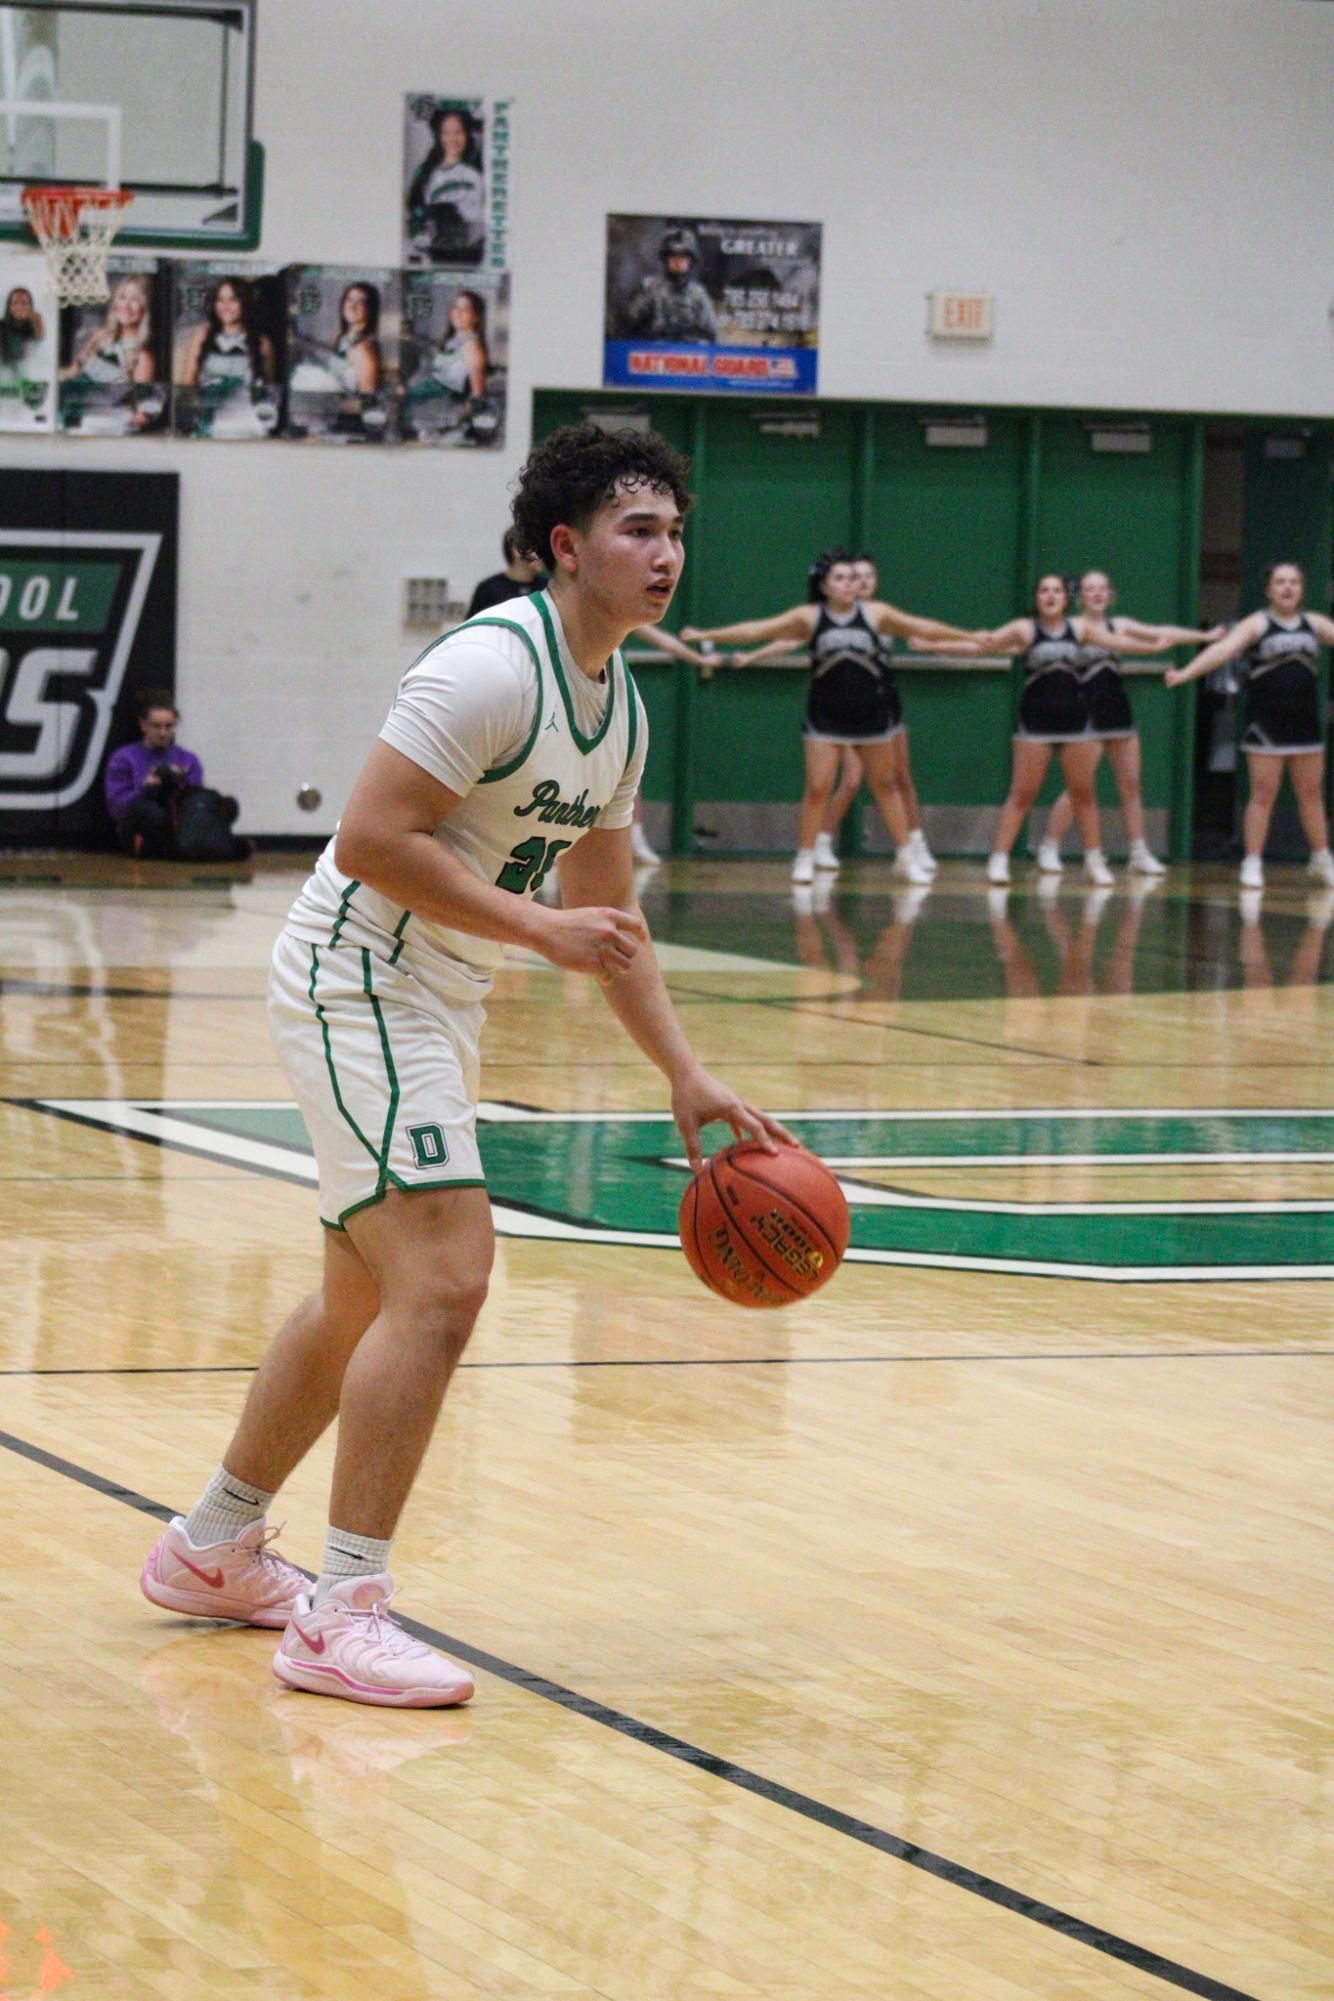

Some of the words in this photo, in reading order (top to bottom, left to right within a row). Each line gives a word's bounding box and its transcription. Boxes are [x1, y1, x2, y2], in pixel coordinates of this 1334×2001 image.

[943, 296, 985, 328] EXIT
[628, 351, 709, 377] NATIONAL
[713, 355, 770, 379] GUARD
[405, 1121, 451, 1171] D
[751, 1214, 819, 1282] LEGACY
